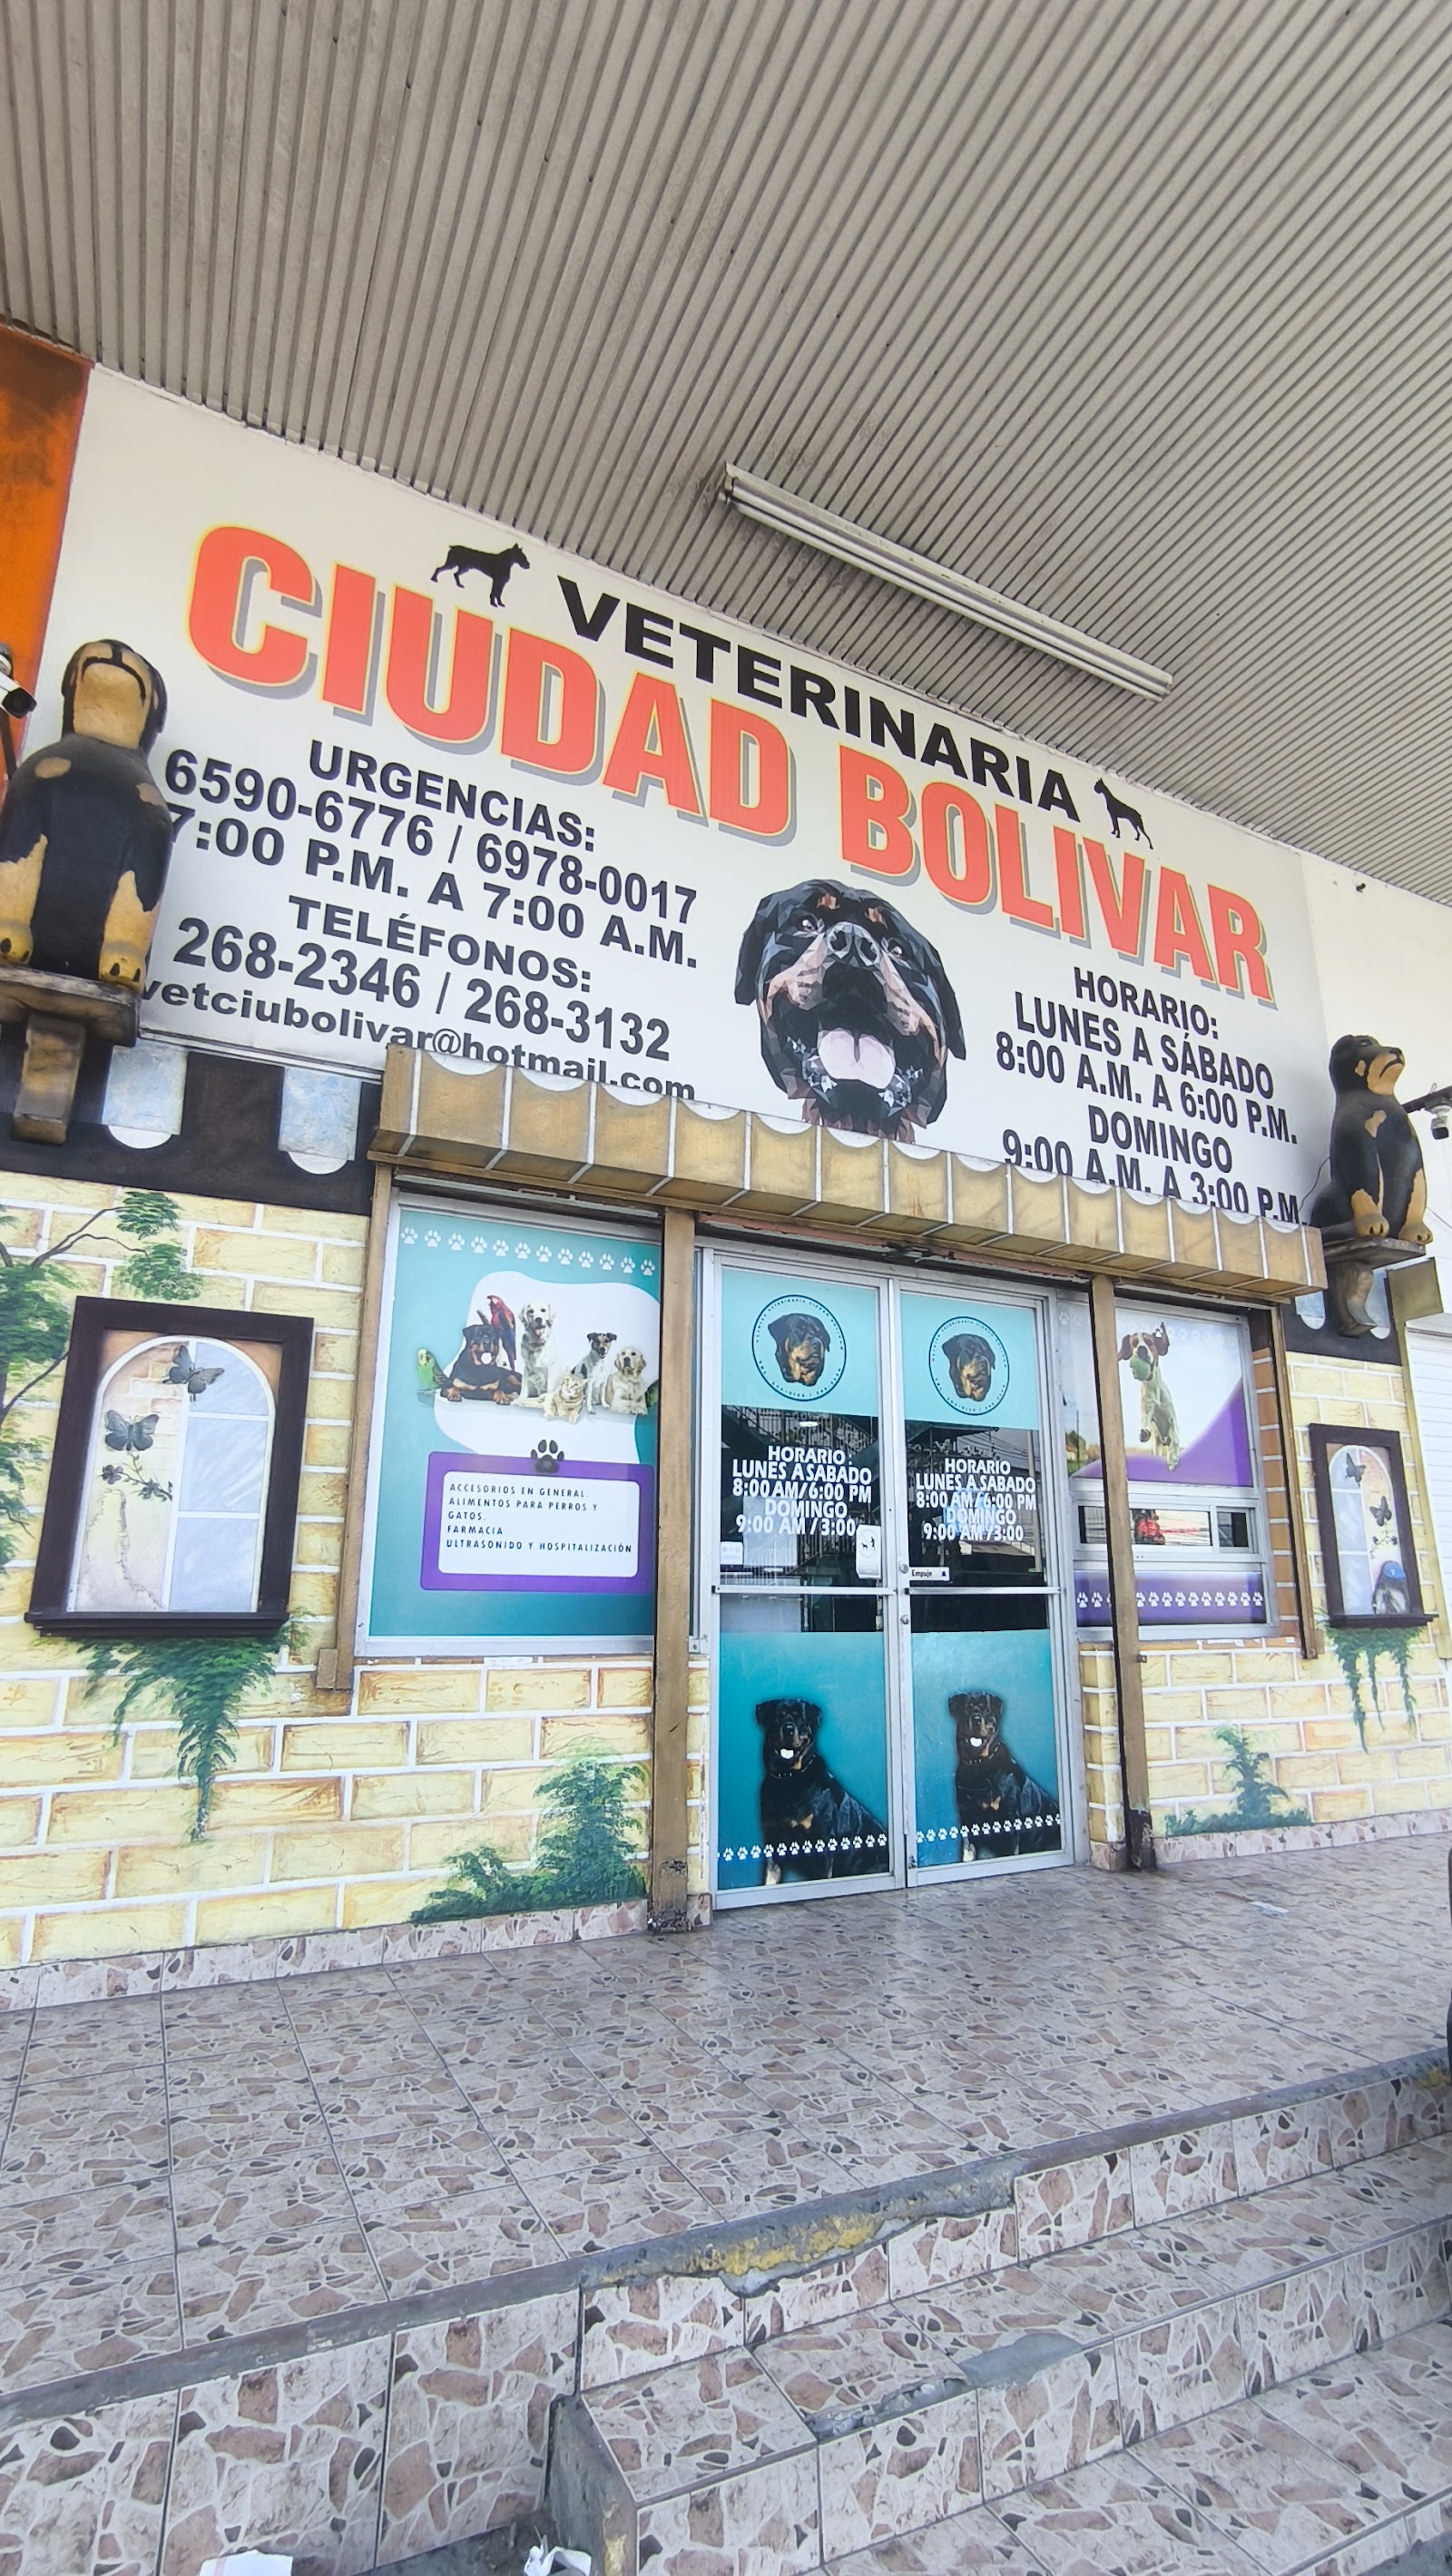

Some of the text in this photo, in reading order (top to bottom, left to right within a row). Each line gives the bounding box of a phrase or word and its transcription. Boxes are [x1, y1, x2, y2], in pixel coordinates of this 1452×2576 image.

[557, 575, 1080, 822] VETERINARIA
[187, 524, 1278, 1009] CIUDAD BOLIVAR
[309, 739, 594, 852] URGENCIAS:
[165, 749, 433, 856] 6590-6776
[476, 832, 697, 923] 6978-0017
[165, 801, 697, 968] 7:00 P.M. A 7:00 A.M.
[289, 895, 591, 992] TELÉFONOS:
[173, 918, 420, 1008] 268-2346
[465, 978, 670, 1061] 268-3132
[1074, 967, 1219, 1039] HORARIO:
[142, 980, 694, 1100] vetciubolivar@hotmail.com
[1015, 991, 1273, 1099] LUNES A SÁBADO
[996, 1031, 1298, 1145] 8:00 A.M. A 6:00 P.M.
[1088, 1105, 1232, 1174] DOMINGO
[1003, 1129, 1073, 1176] 9:00
[1087, 1148, 1152, 1194] A.M.
[1163, 1165, 1182, 1200] A
[1190, 1172, 1249, 1214] 3:00
[450, 1483, 515, 1494] ACCESORIOS
[522, 1487, 534, 1495] EN
[732, 1459, 787, 1480] LUNES
[806, 1464, 872, 1485] SABADO
[916, 1473, 1035, 1493] LUNES A SABADO
[945, 1458, 1011, 1474] HORARIO
[449, 1498, 510, 1508] ALIMENTOS
[516, 1500, 543, 1509] PARA
[549, 1502, 586, 1511] PERROS
[732, 1478, 770, 1497] 8:00
[849, 1485, 871, 1503] PM
[765, 1499, 848, 1519] DOMINGO
[916, 1491, 947, 1508] 8:00
[1017, 1493, 1036, 1510] PM
[447, 1525, 503, 1535] FARMACIA
[736, 1515, 773, 1533] 9:00
[778, 1517, 805, 1534] AM
[923, 1522, 956, 1540] 9:00
[947, 1507, 1016, 1525] DOMINGO
[446, 1539, 523, 1549] ULTRASONIDO
[539, 1543, 632, 1553] HOSPITALIZACIÓN
